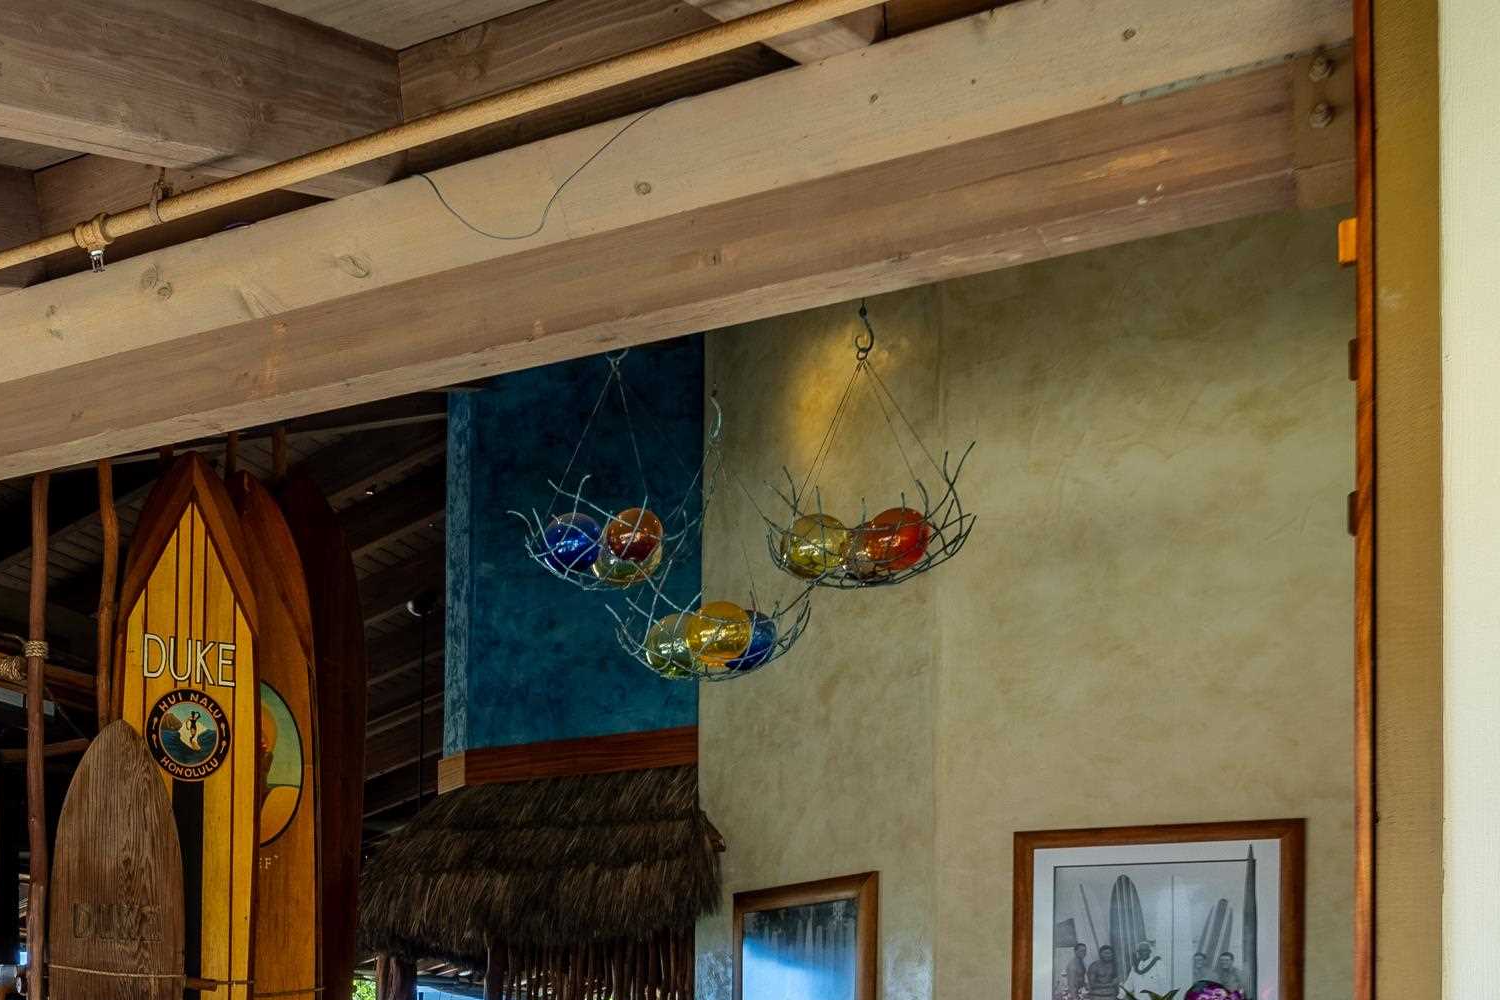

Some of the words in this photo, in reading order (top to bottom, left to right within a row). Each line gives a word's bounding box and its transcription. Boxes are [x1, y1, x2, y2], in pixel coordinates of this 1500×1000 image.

[142, 632, 236, 688] DUKE
[158, 692, 183, 712] HUI
[190, 693, 223, 721] NALU
[160, 756, 220, 778] HONOLULU
[72, 903, 163, 942] DUKE
